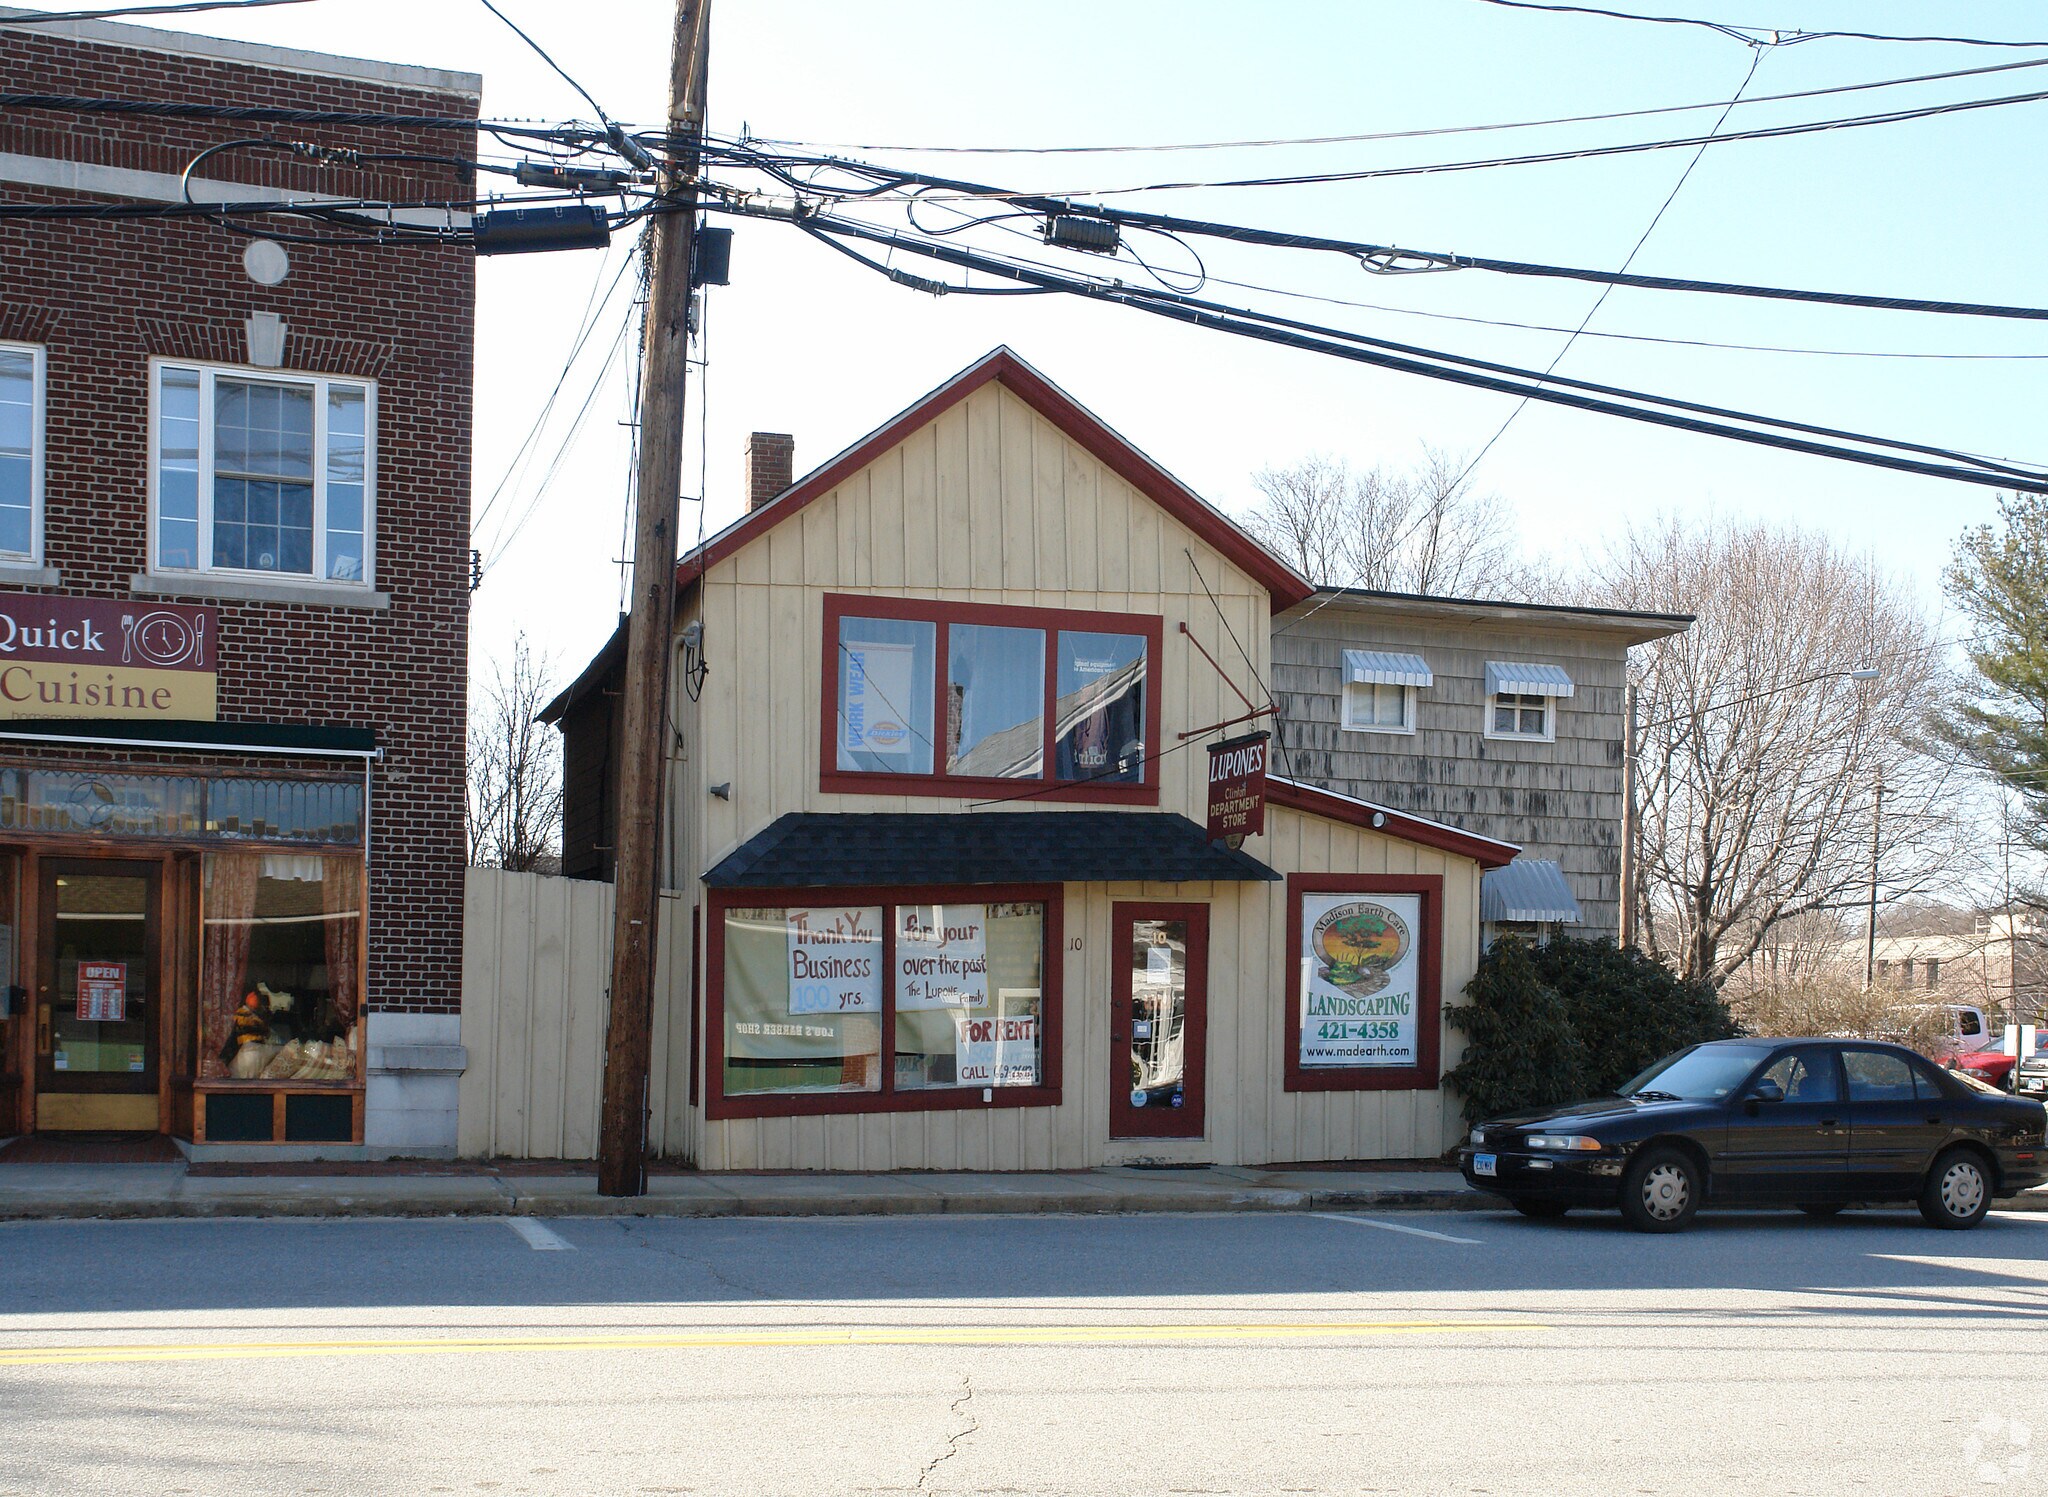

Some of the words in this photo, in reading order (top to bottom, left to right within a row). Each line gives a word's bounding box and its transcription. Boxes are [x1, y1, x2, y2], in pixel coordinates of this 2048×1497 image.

[0, 613, 104, 652] Quick
[849, 651, 865, 696] WEAR
[0, 666, 172, 710] Cuisine
[849, 702, 864, 747] WORK
[1225, 785, 1247, 800] Clinton
[1210, 795, 1260, 817] DEPARTMENT
[1222, 812, 1247, 829] STORE
[789, 911, 846, 945] Thank
[844, 911, 873, 944] You
[904, 914, 932, 942] for
[936, 925, 979, 949] your
[1316, 907, 1354, 934] Madison
[1357, 904, 1385, 917] Earth
[1387, 912, 1406, 935] Care
[1070, 937, 1083, 951] 10
[1152, 931, 1167, 945] 10
[86, 966, 119, 978] OPEN
[793, 949, 871, 979] Business
[903, 958, 937, 976] over
[937, 953, 960, 975] the
[962, 953, 987, 980] past
[793, 984, 830, 1012] 100
[839, 991, 864, 1010] yrs.
[904, 980, 921, 997] The
[959, 989, 984, 1005] Family
[1307, 991, 1410, 1016] LANDSCAPING
[961, 1020, 992, 1043] FOR
[995, 1018, 1034, 1041] RENT
[1317, 1021, 1399, 1039] 421-4358
[1306, 1044, 1410, 1057] www.madearth.com
[961, 1065, 989, 1080] CALL
